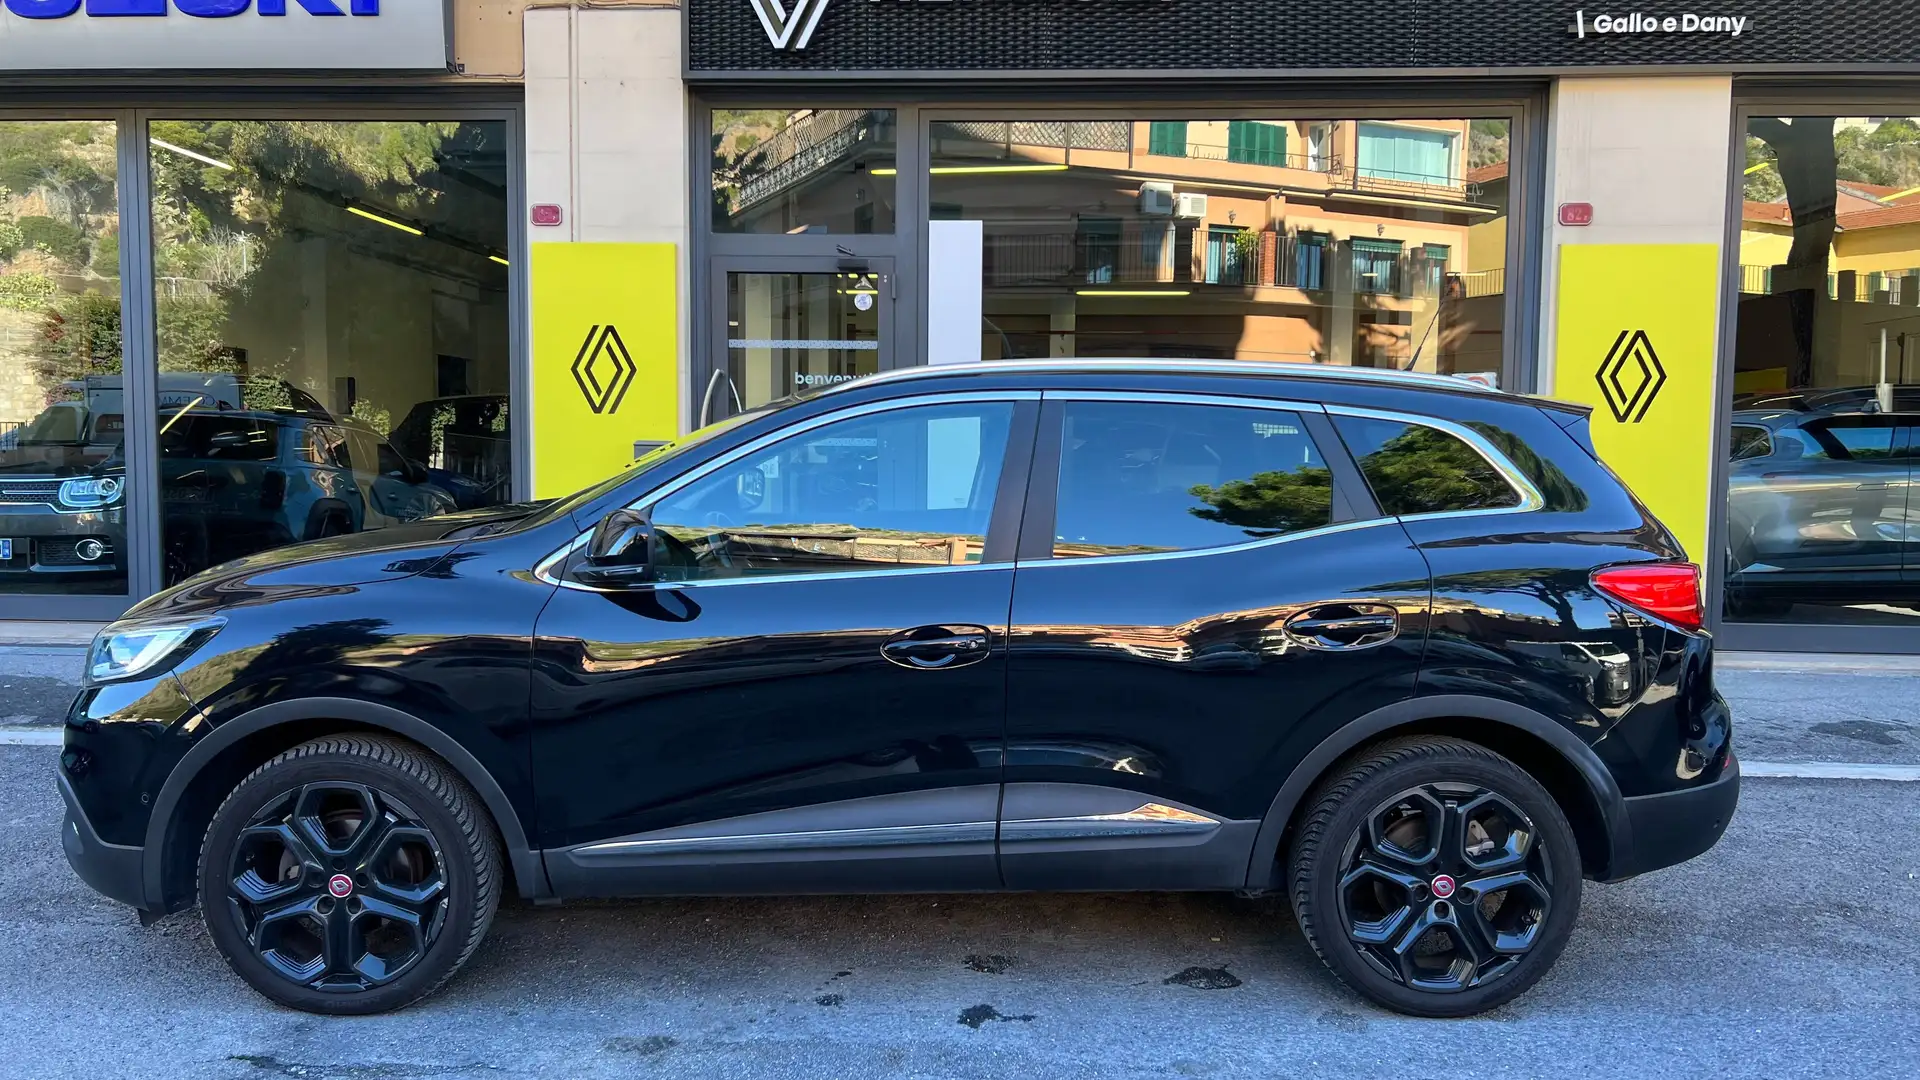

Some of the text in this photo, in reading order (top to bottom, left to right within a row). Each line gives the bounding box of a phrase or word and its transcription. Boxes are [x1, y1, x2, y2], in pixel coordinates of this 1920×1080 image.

[1593, 13, 1747, 36] Gallo e Dany
